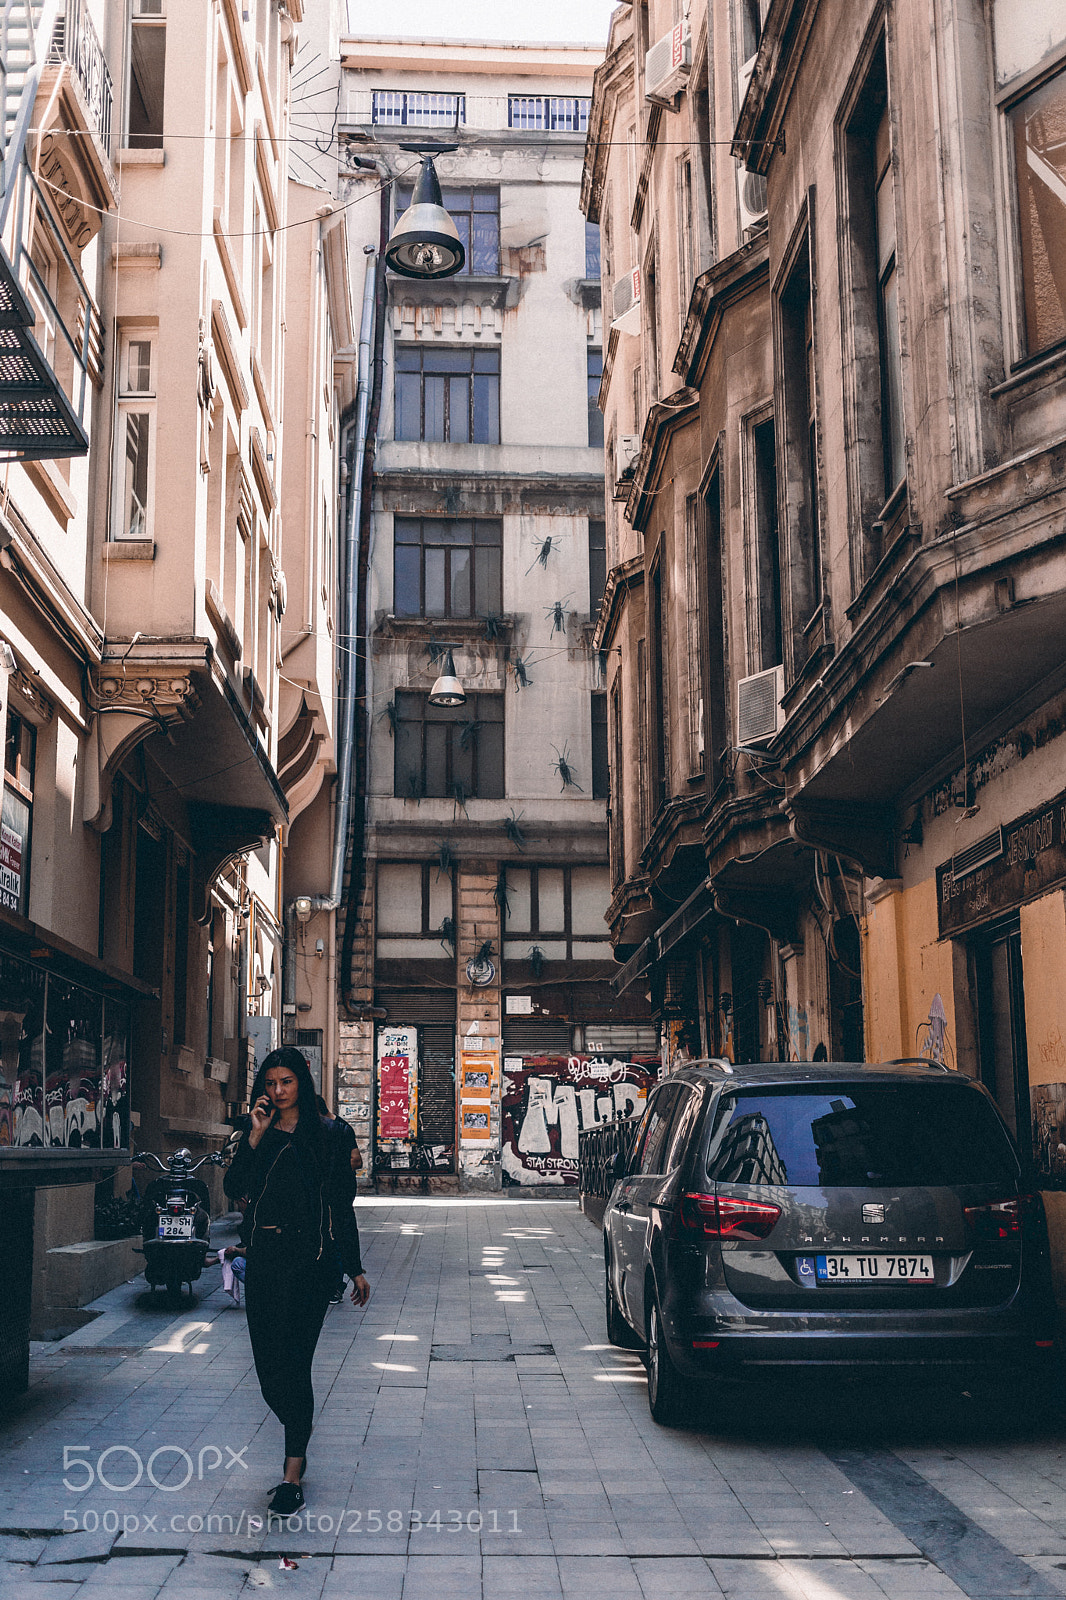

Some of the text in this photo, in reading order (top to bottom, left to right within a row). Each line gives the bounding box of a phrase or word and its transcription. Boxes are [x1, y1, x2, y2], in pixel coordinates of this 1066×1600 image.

[381, 1059, 409, 1083] bahar
[380, 1099, 409, 1123] bahar
[526, 1156, 546, 1169] STAY
[161, 1217, 173, 1226] 59
[827, 1258, 849, 1277] 34
[857, 1258, 878, 1277] TU
[886, 1258, 930, 1277] 7874
